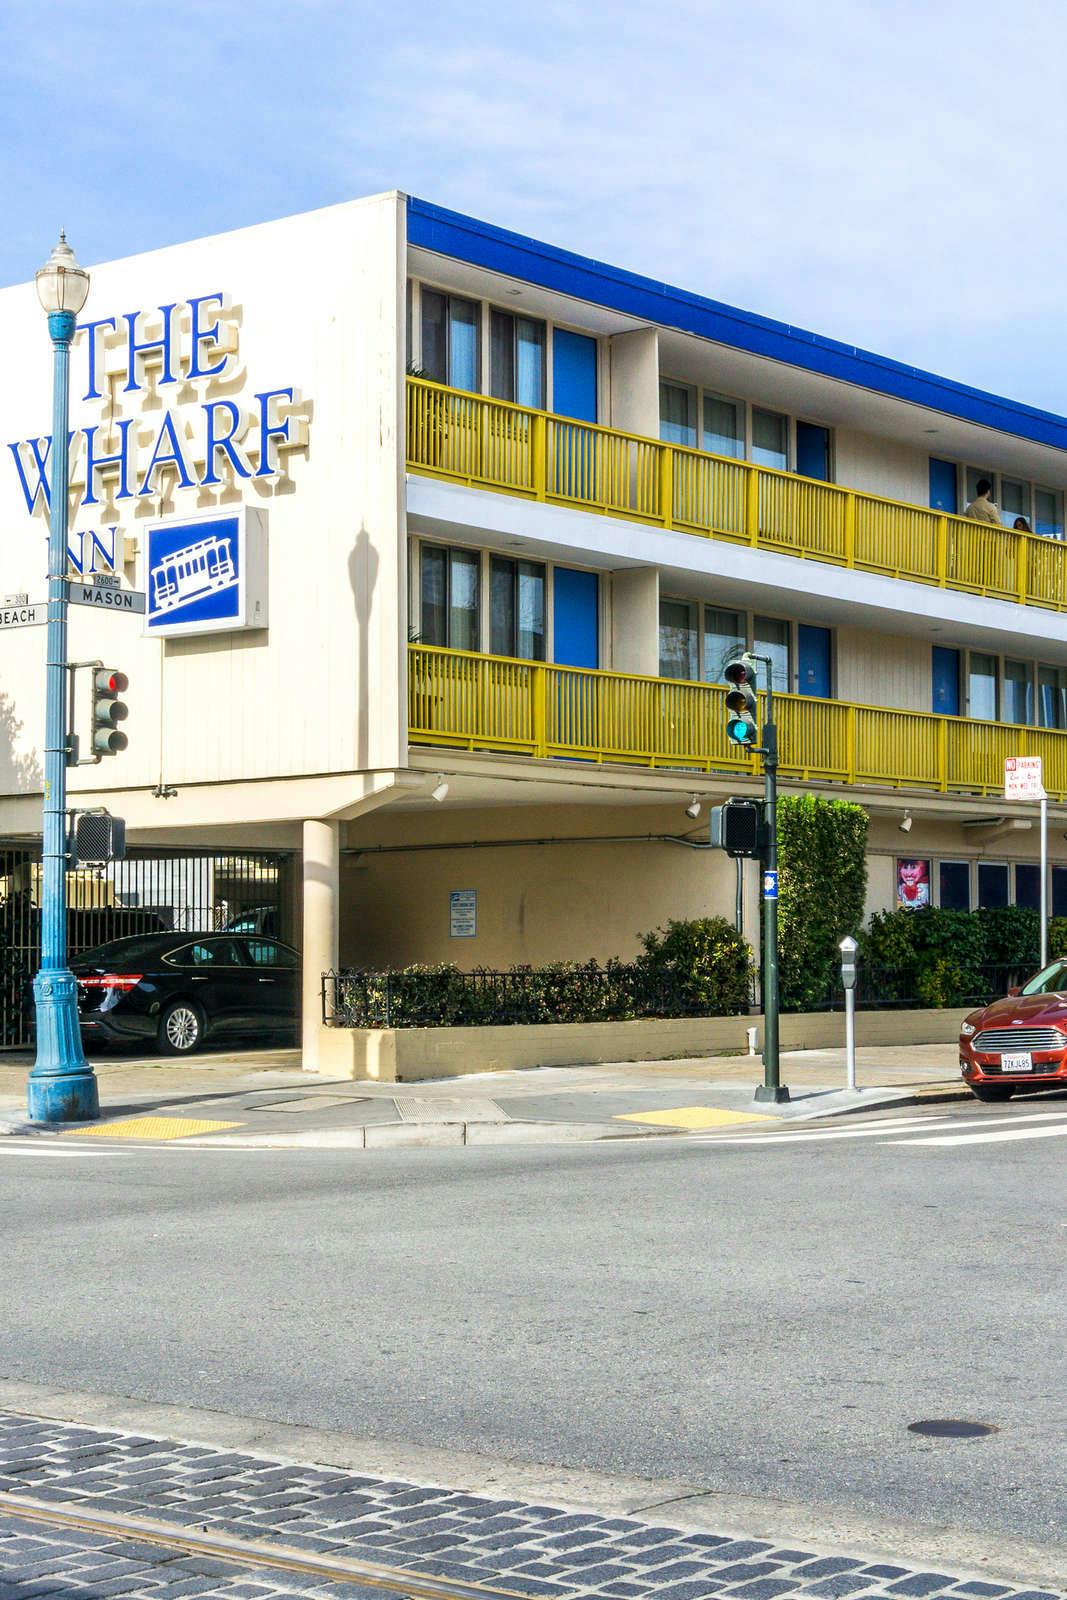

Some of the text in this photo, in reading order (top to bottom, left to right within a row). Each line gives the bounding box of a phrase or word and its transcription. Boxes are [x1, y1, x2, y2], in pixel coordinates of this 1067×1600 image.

[75, 291, 229, 401] THE
[6, 386, 294, 516] WHARF
[45, 526, 118, 579] NN
[82, 588, 133, 608] MASON
[96, 575, 114, 586] 2600
[1006, 759, 1016, 770] NO
